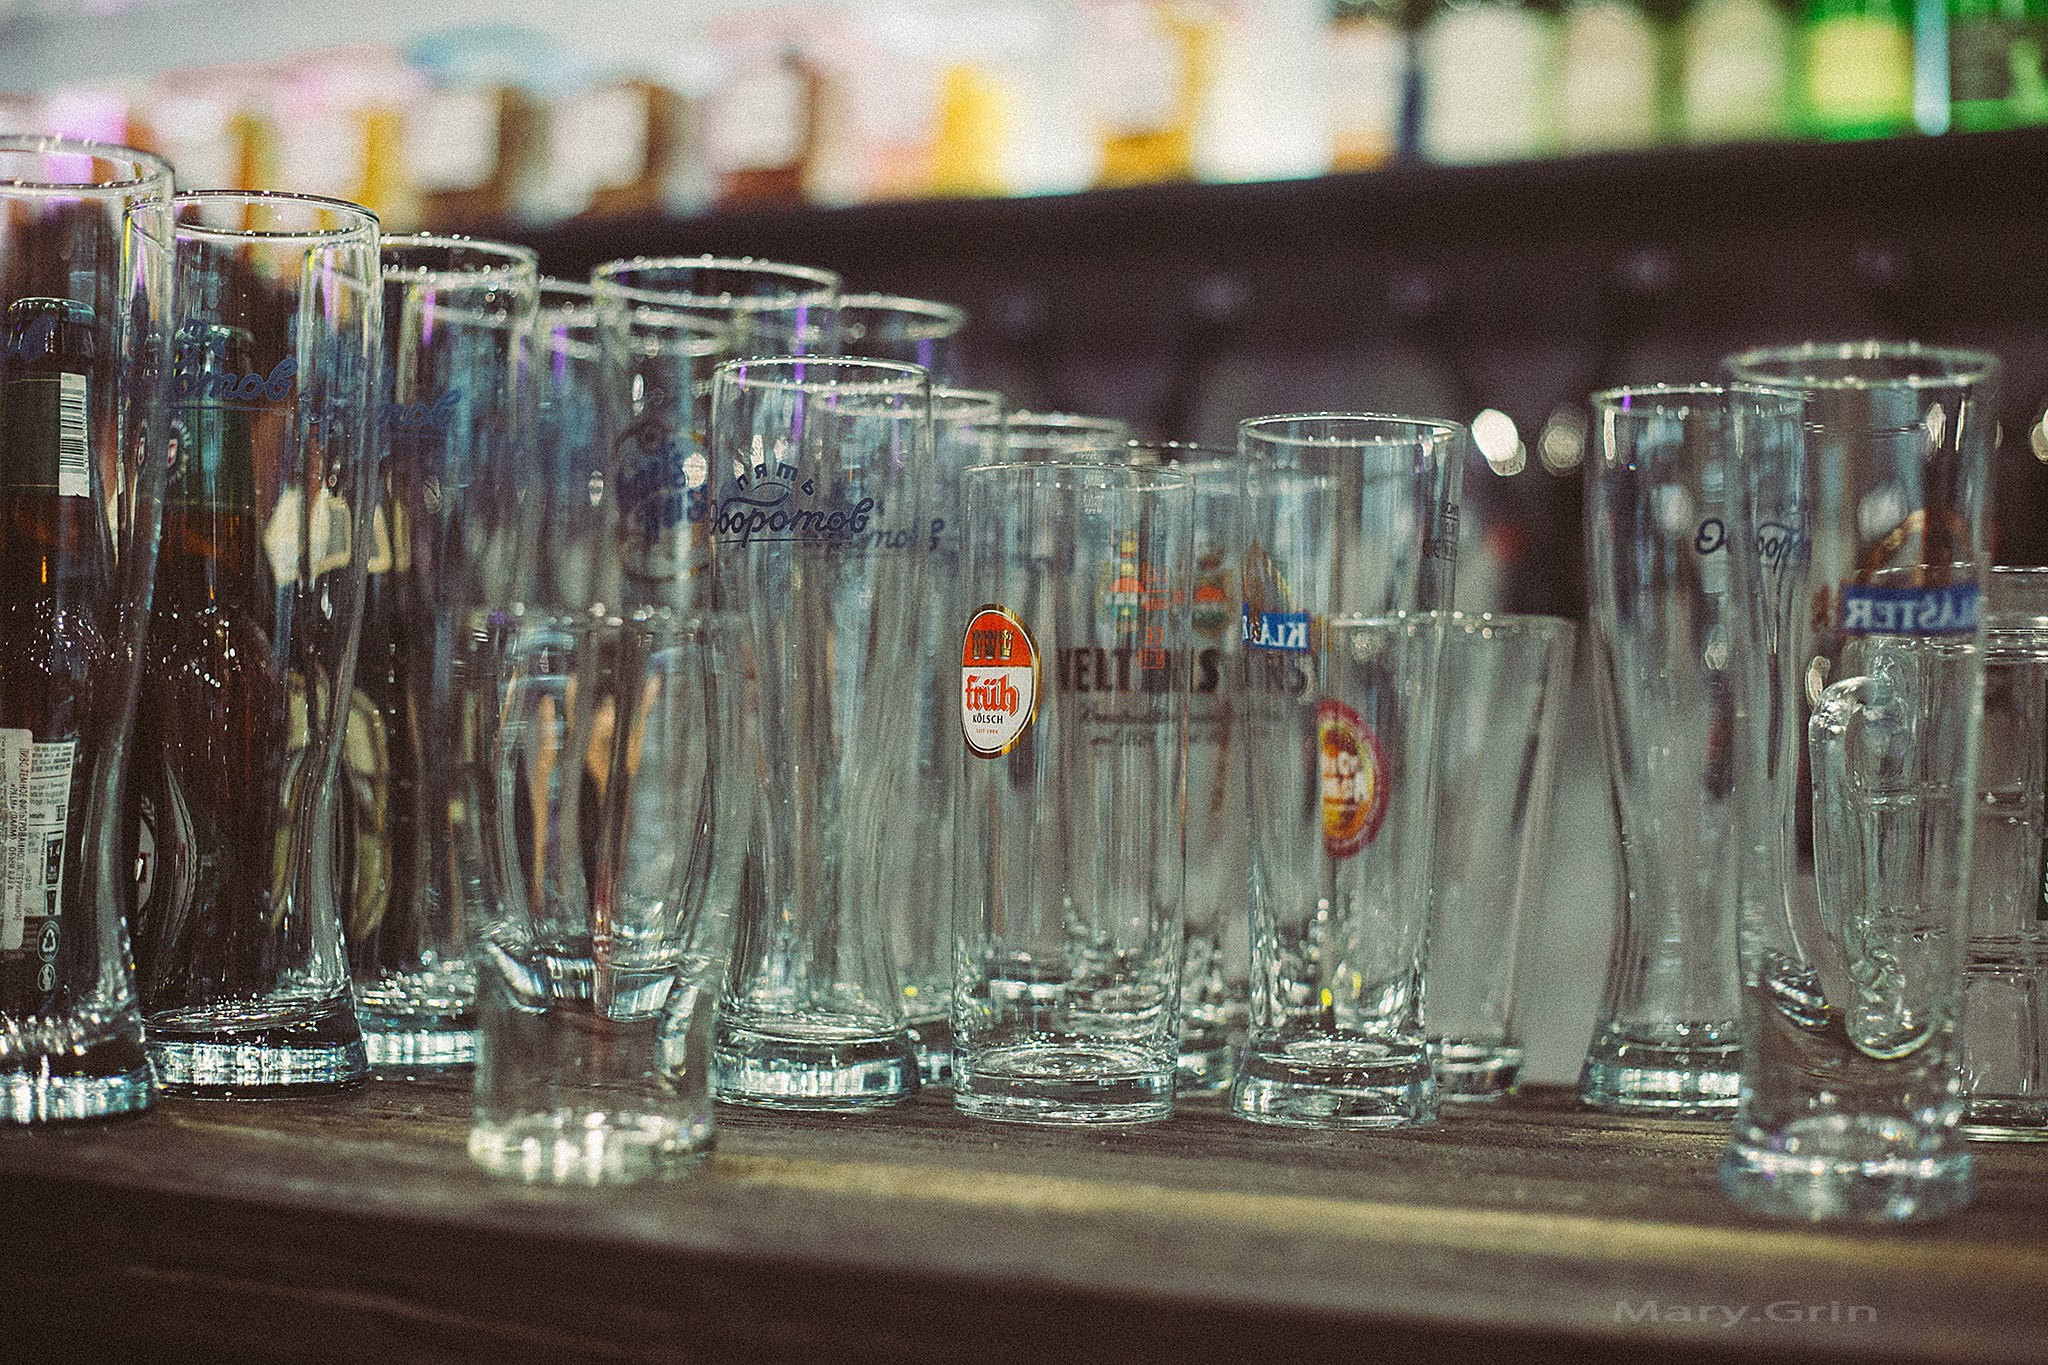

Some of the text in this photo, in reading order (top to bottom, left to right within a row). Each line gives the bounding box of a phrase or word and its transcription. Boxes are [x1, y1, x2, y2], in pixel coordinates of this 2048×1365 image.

[965, 673, 1020, 717] früh
[972, 712, 1003, 725] KÖLSCH
[18, 768, 29, 797] ТЕМНОЕ
